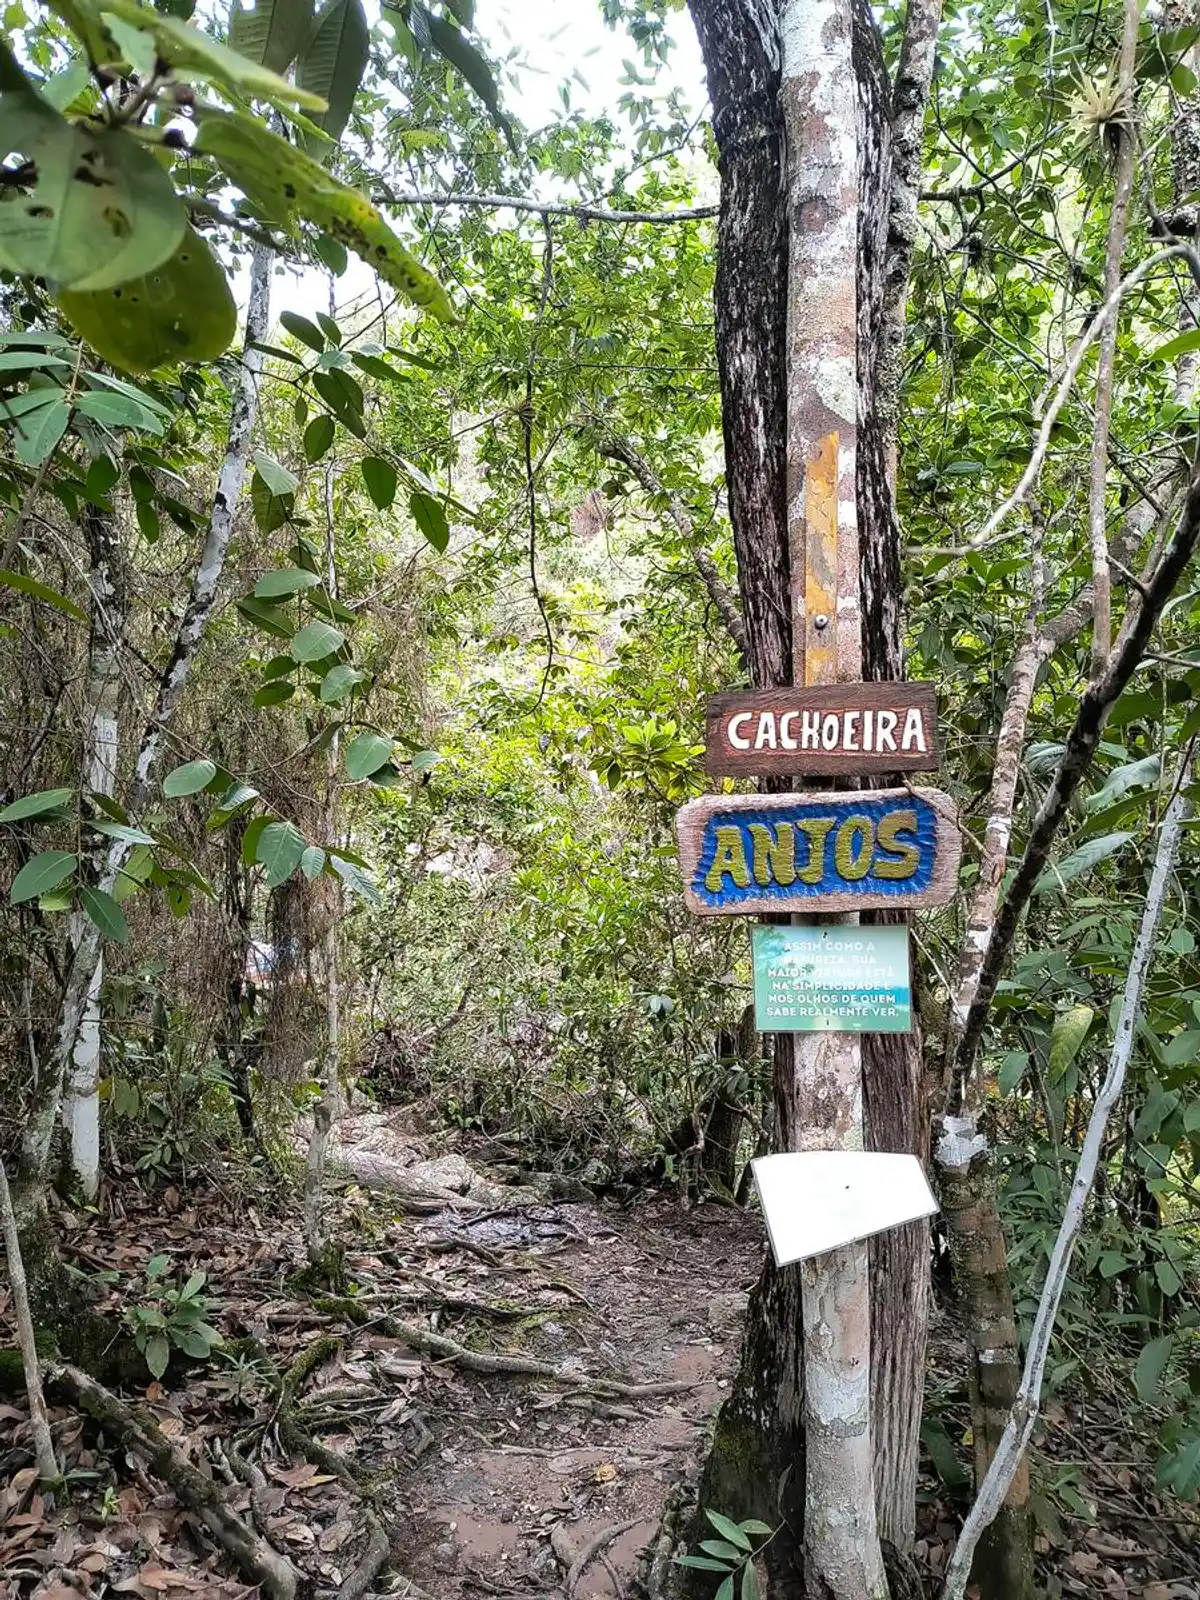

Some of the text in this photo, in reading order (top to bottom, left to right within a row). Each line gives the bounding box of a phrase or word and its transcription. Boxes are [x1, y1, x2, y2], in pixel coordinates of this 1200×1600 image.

[727, 708, 926, 752] CACHOEIRA
[705, 810, 920, 893] ANJOS
[783, 941, 876, 951] ASSIM COMO A
[851, 954, 877, 964] SUA
[767, 967, 808, 978] MAIOR
[772, 981, 789, 990] NA
[792, 981, 880, 991] SIMPLICIDADE
[768, 994, 896, 1004] NOS OLHOS DE QUEM
[766, 1007, 899, 1017] SABE REALMENTE VER.
